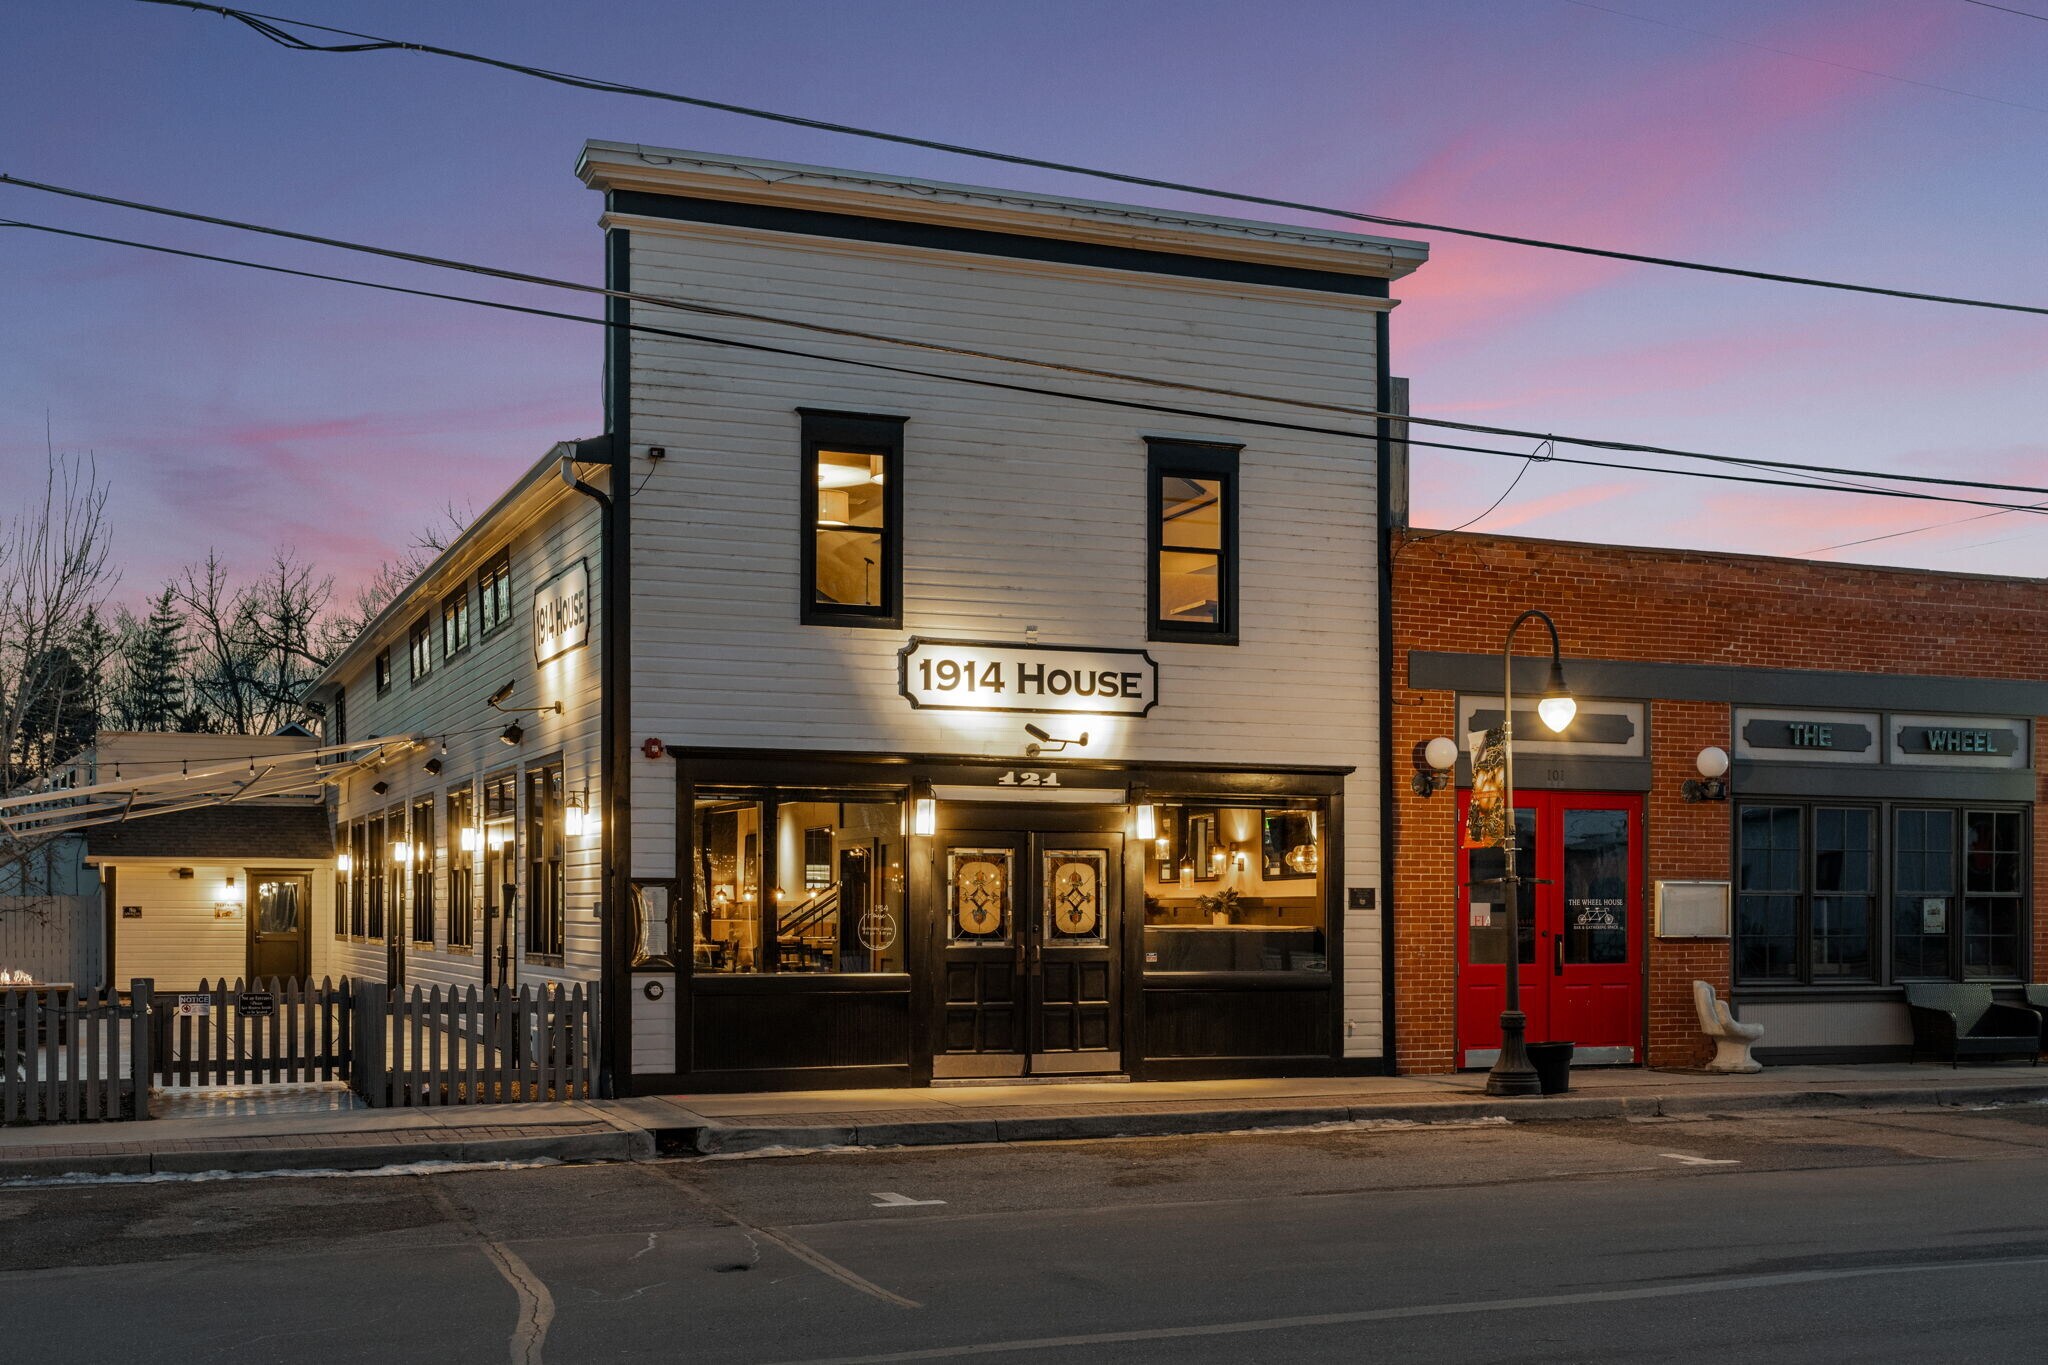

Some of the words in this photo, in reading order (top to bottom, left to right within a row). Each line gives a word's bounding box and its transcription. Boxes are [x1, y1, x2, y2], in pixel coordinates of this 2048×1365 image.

[536, 601, 555, 647] 1914
[919, 658, 1006, 693] 1914
[1016, 662, 1143, 699] HOUSE
[1789, 723, 1833, 747] THE
[1927, 728, 1998, 753] WHEEL
